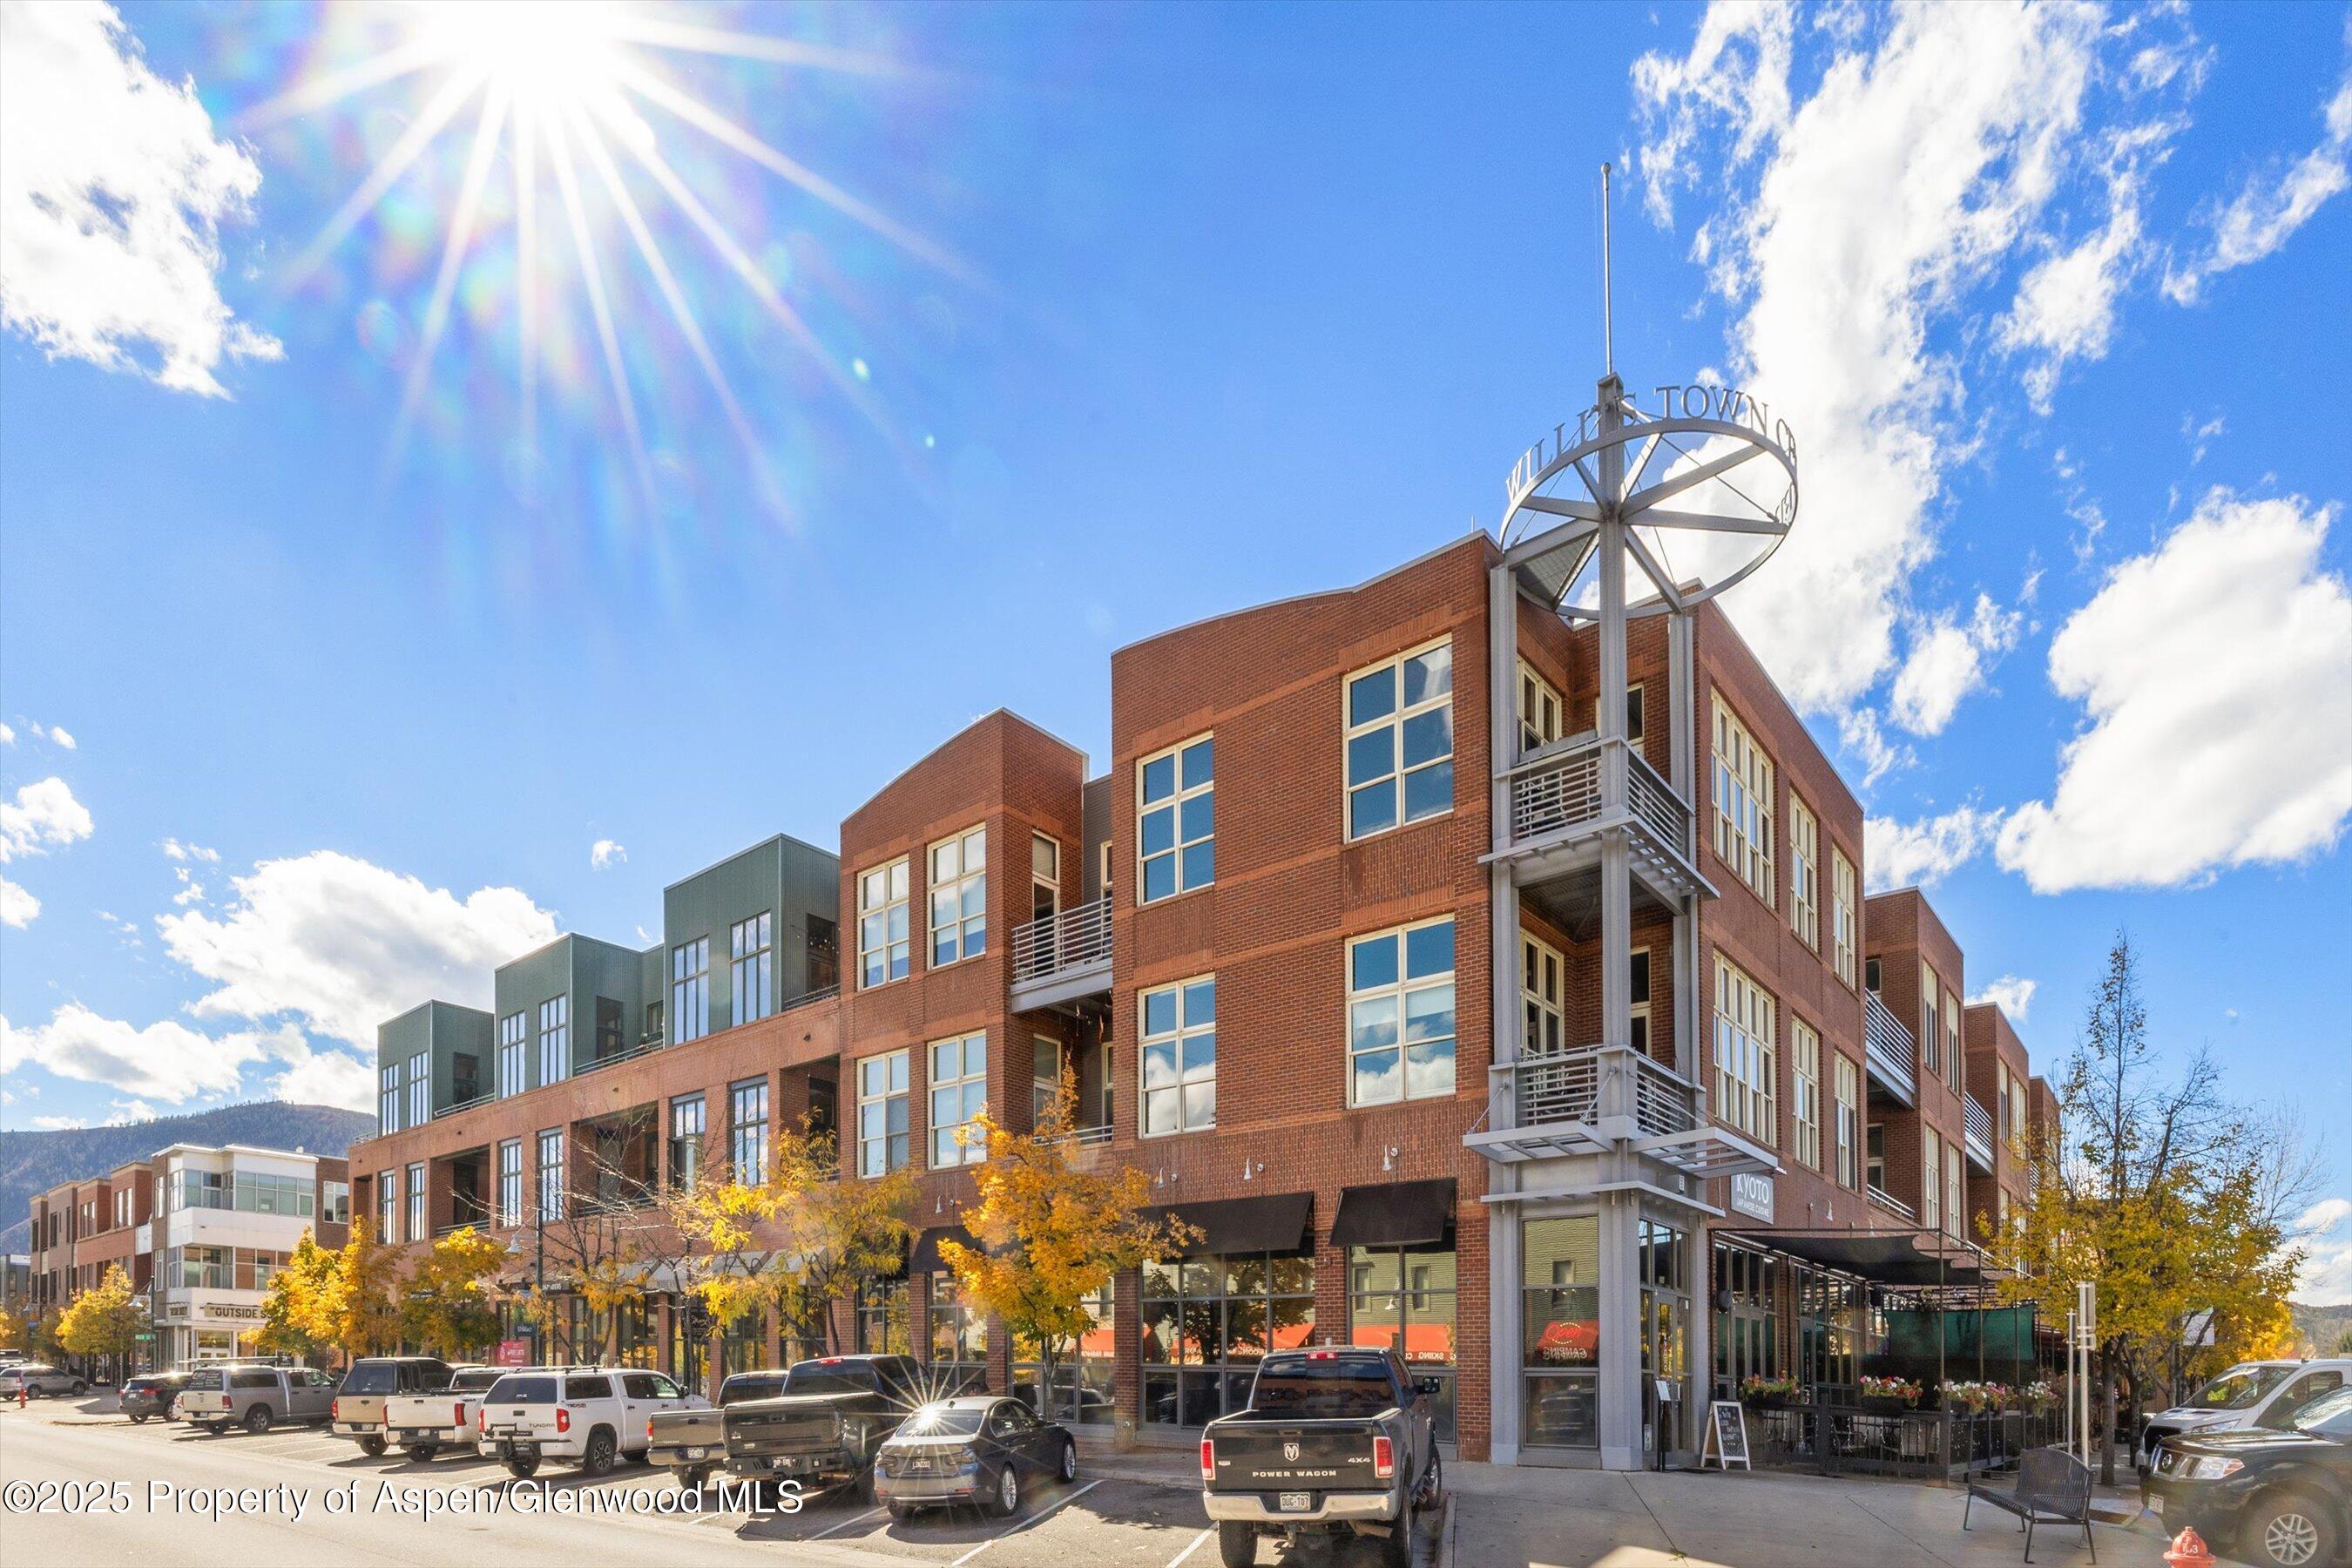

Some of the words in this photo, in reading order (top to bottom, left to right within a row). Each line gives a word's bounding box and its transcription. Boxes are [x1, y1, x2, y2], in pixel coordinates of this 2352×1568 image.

[1655, 384, 1769, 436] TOWN
[1736, 1173, 1770, 1205] KYOTO
[215, 1307, 258, 1318] OUTSIDE
[1546, 1322, 1583, 1340] Open
